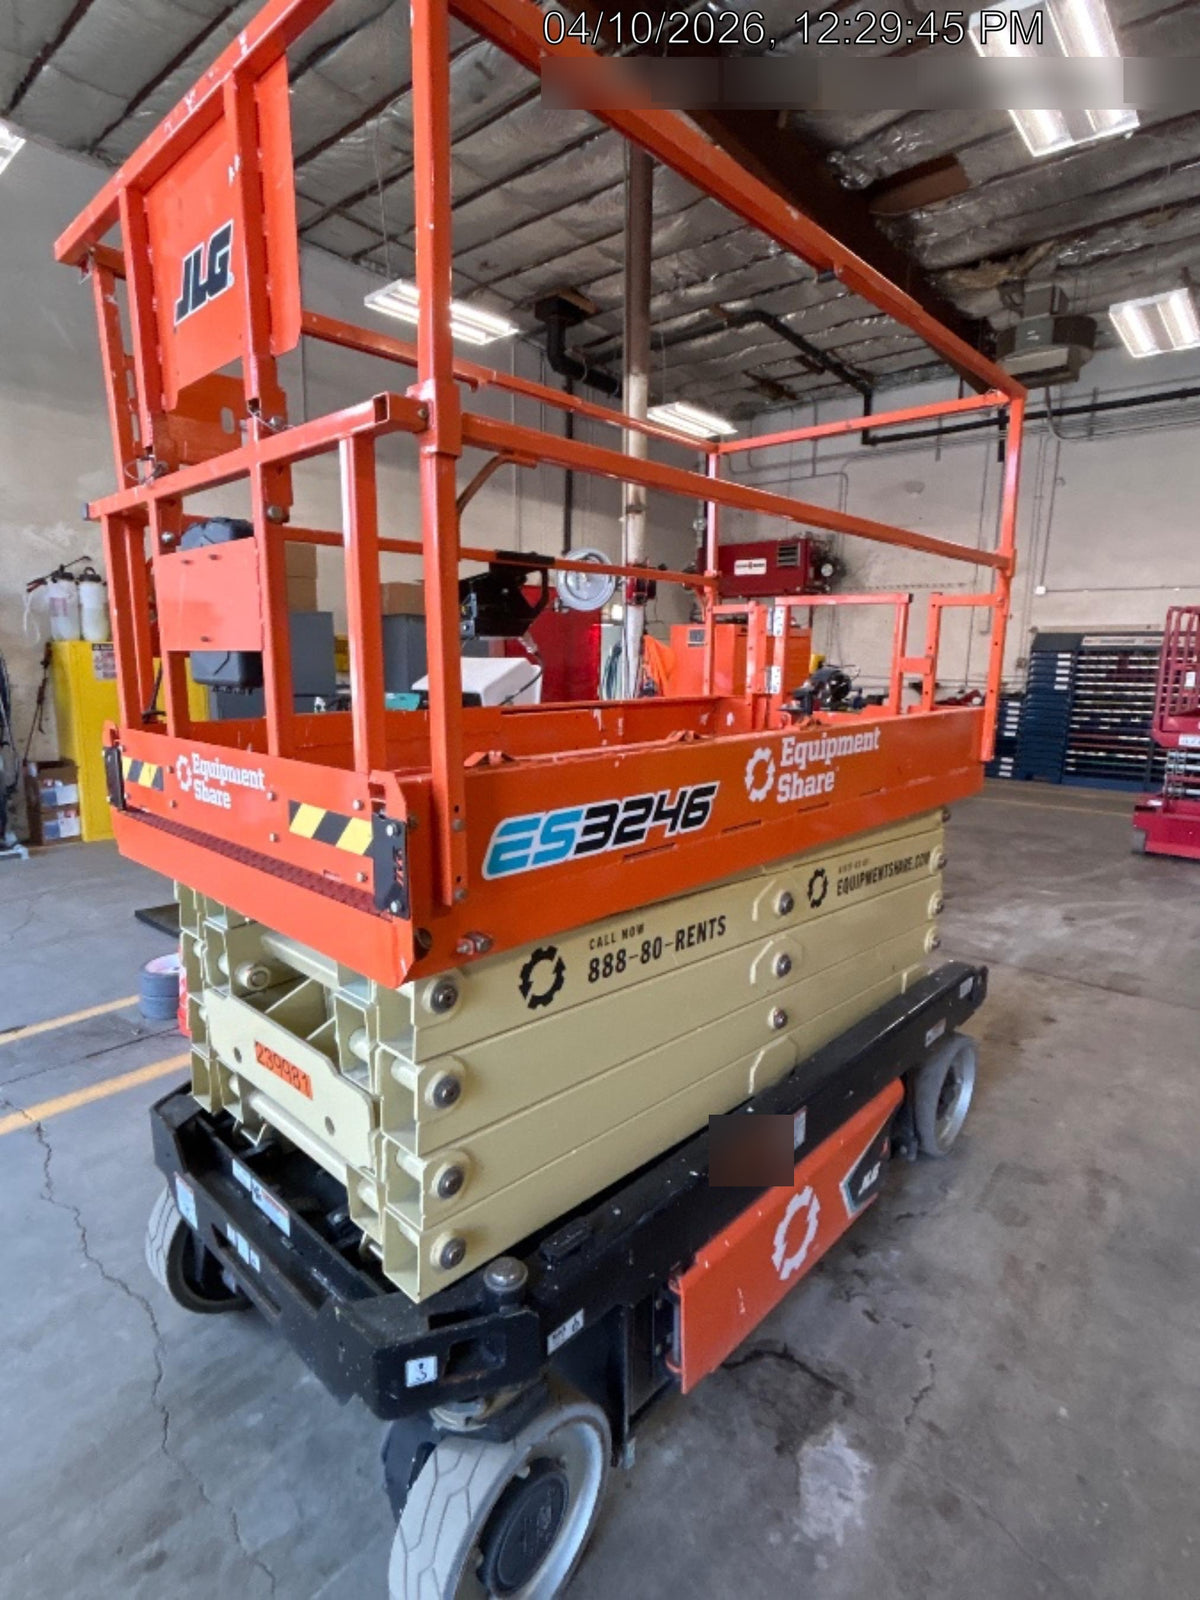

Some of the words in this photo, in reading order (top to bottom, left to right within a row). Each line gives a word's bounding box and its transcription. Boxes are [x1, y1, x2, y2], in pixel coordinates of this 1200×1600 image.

[174, 219, 232, 326] JLG
[780, 727, 881, 770] Equipment
[192, 752, 265, 791] Equipment
[776, 771, 835, 803] Share
[193, 779, 232, 809] Share
[482, 781, 720, 881] ES3246
[588, 932, 617, 950] CALL
[621, 922, 645, 941] NOW
[588, 915, 726, 983] 888-80-RENTS
[255, 1041, 313, 1100] 239981
